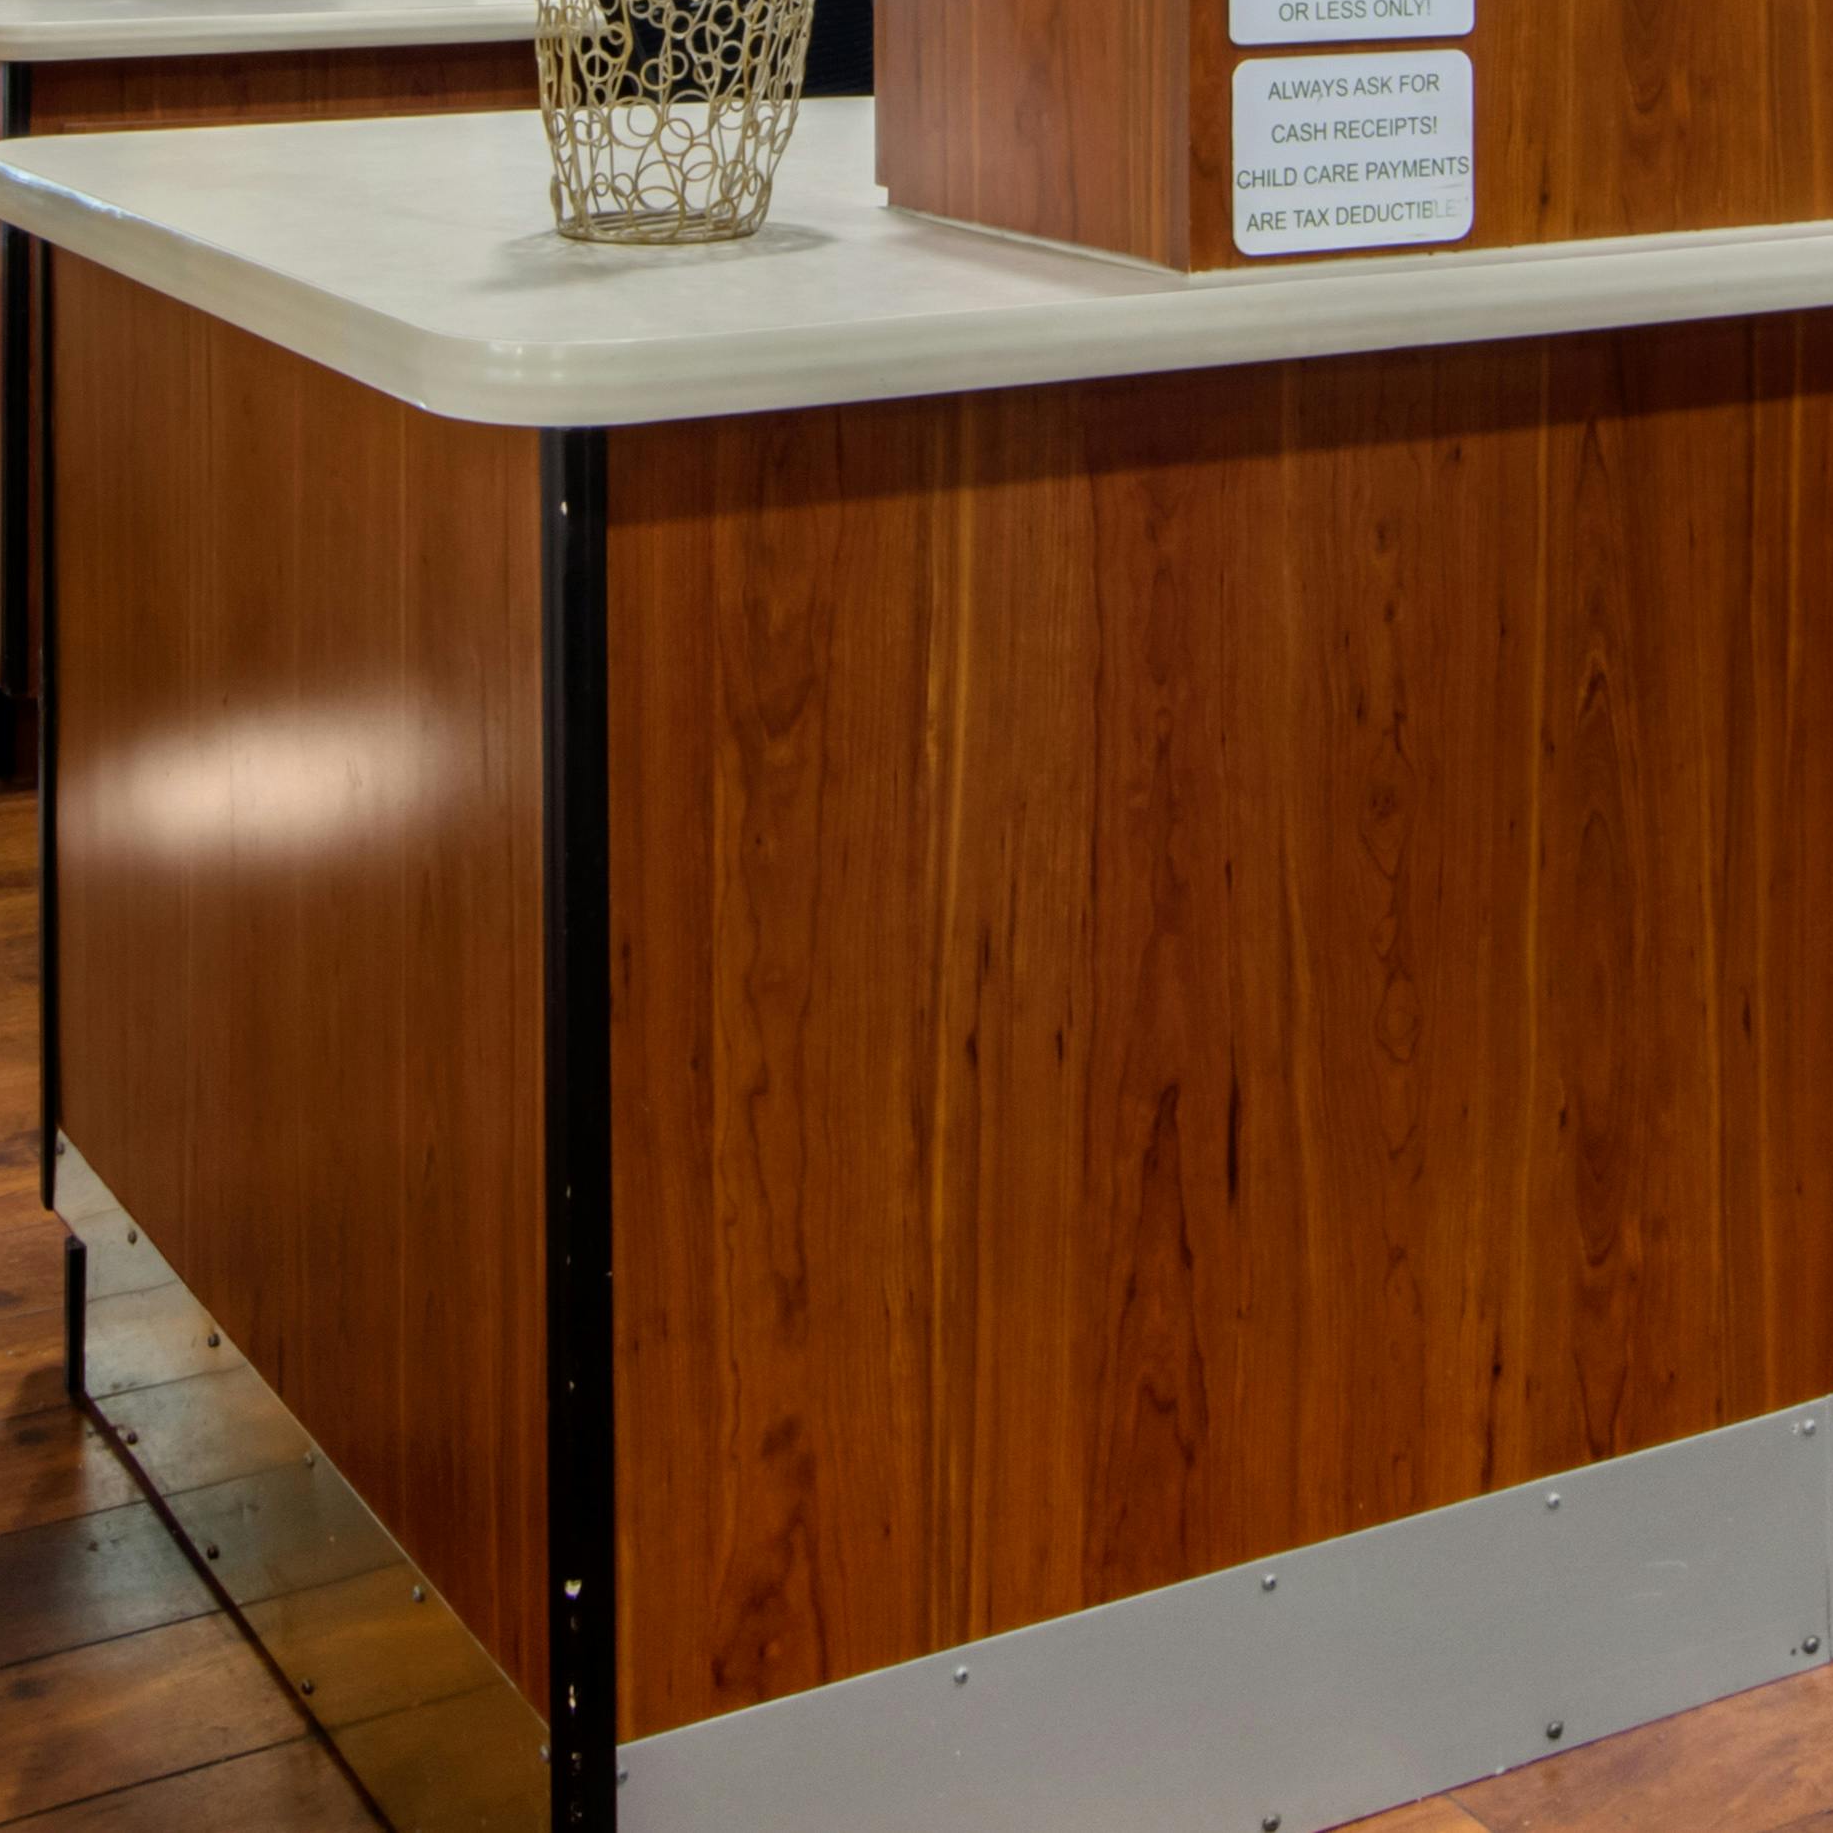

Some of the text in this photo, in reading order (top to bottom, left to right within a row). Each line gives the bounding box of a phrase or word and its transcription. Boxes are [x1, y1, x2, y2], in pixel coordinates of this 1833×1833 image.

[1278, 3, 1309, 21] OR
[1316, 0, 1367, 20] LESS
[1268, 74, 1440, 101] ALWAYS ASK FOR
[1271, 116, 1437, 143] CASH RECEIPTS!
[1236, 156, 1470, 189] CHILD CARE PAYMENTS
[1246, 211, 1286, 232] ARE
[1293, 208, 1330, 229] TAX
